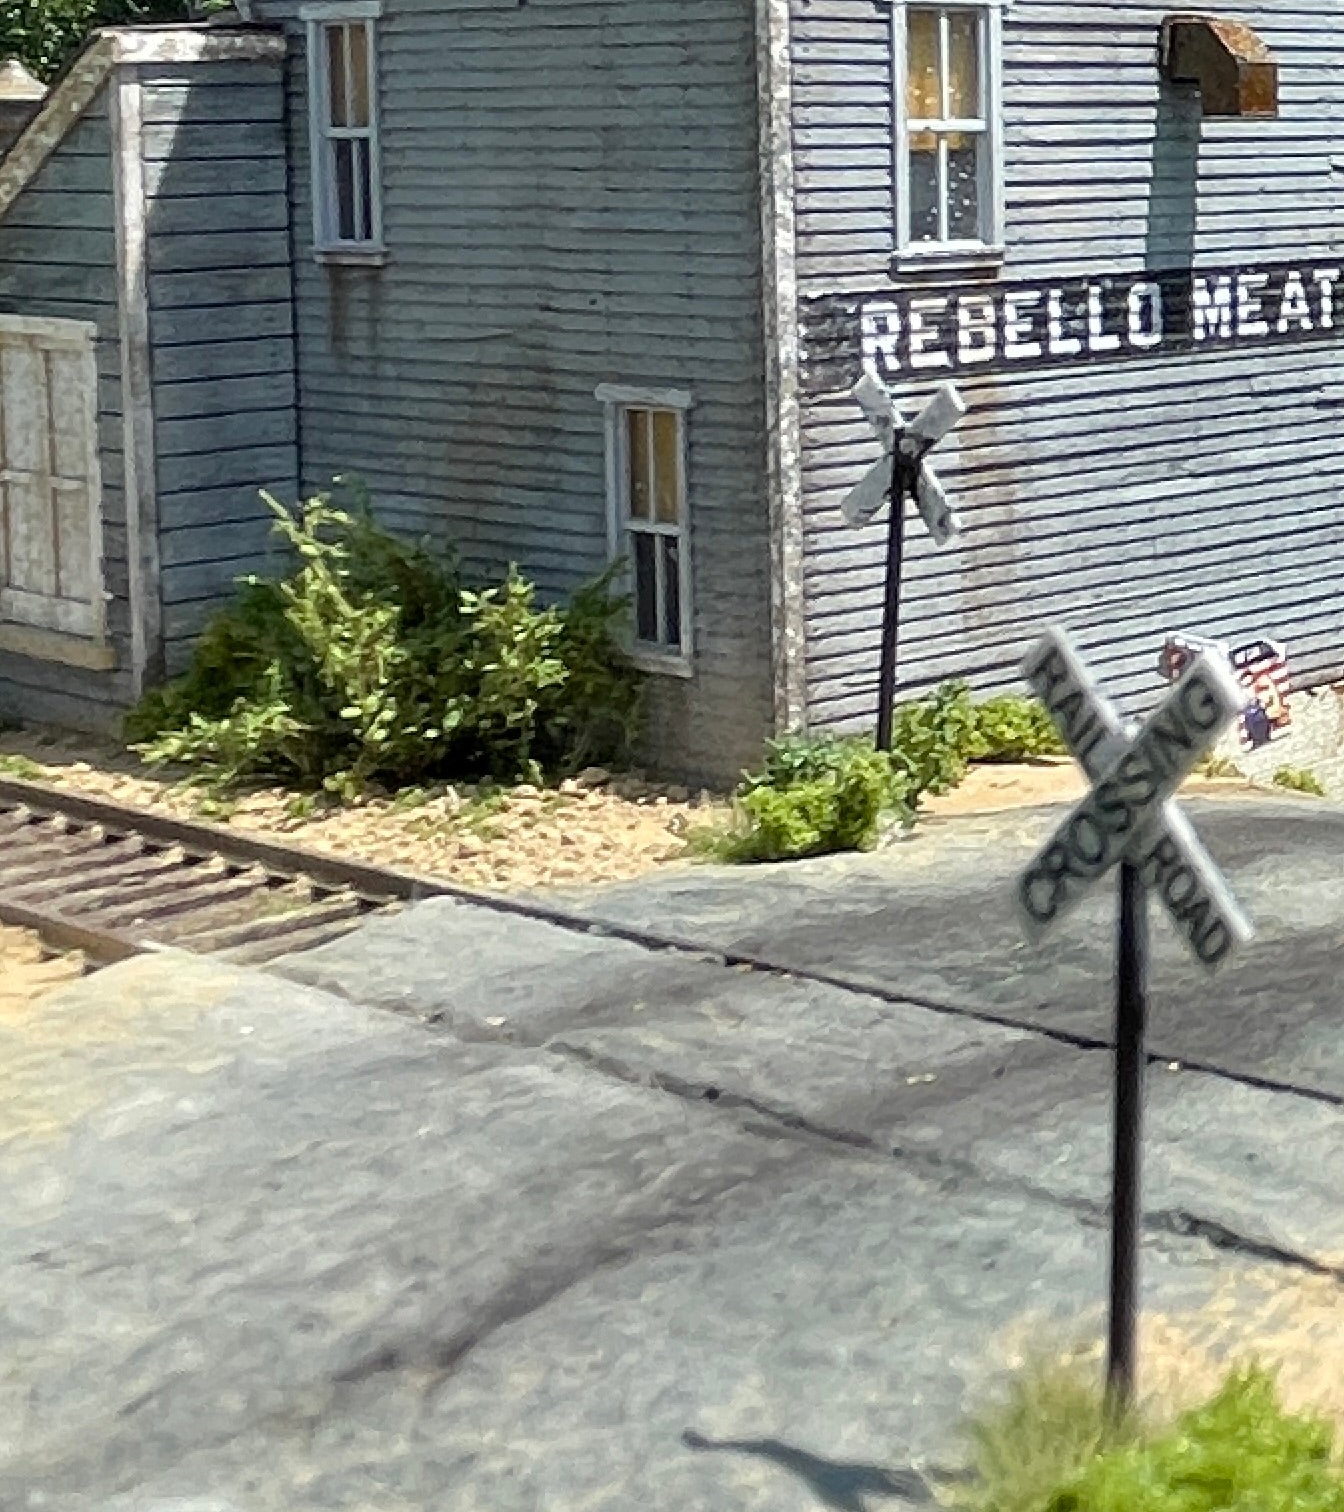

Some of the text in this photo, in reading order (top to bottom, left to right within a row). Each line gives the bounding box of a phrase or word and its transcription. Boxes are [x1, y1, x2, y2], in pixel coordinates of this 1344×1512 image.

[860, 282, 1163, 371] REBELLO
[1192, 267, 1341, 340] MEAT
[1019, 672, 1221, 923] CROSSING
[1029, 645, 1232, 964] RAIL ROAD
